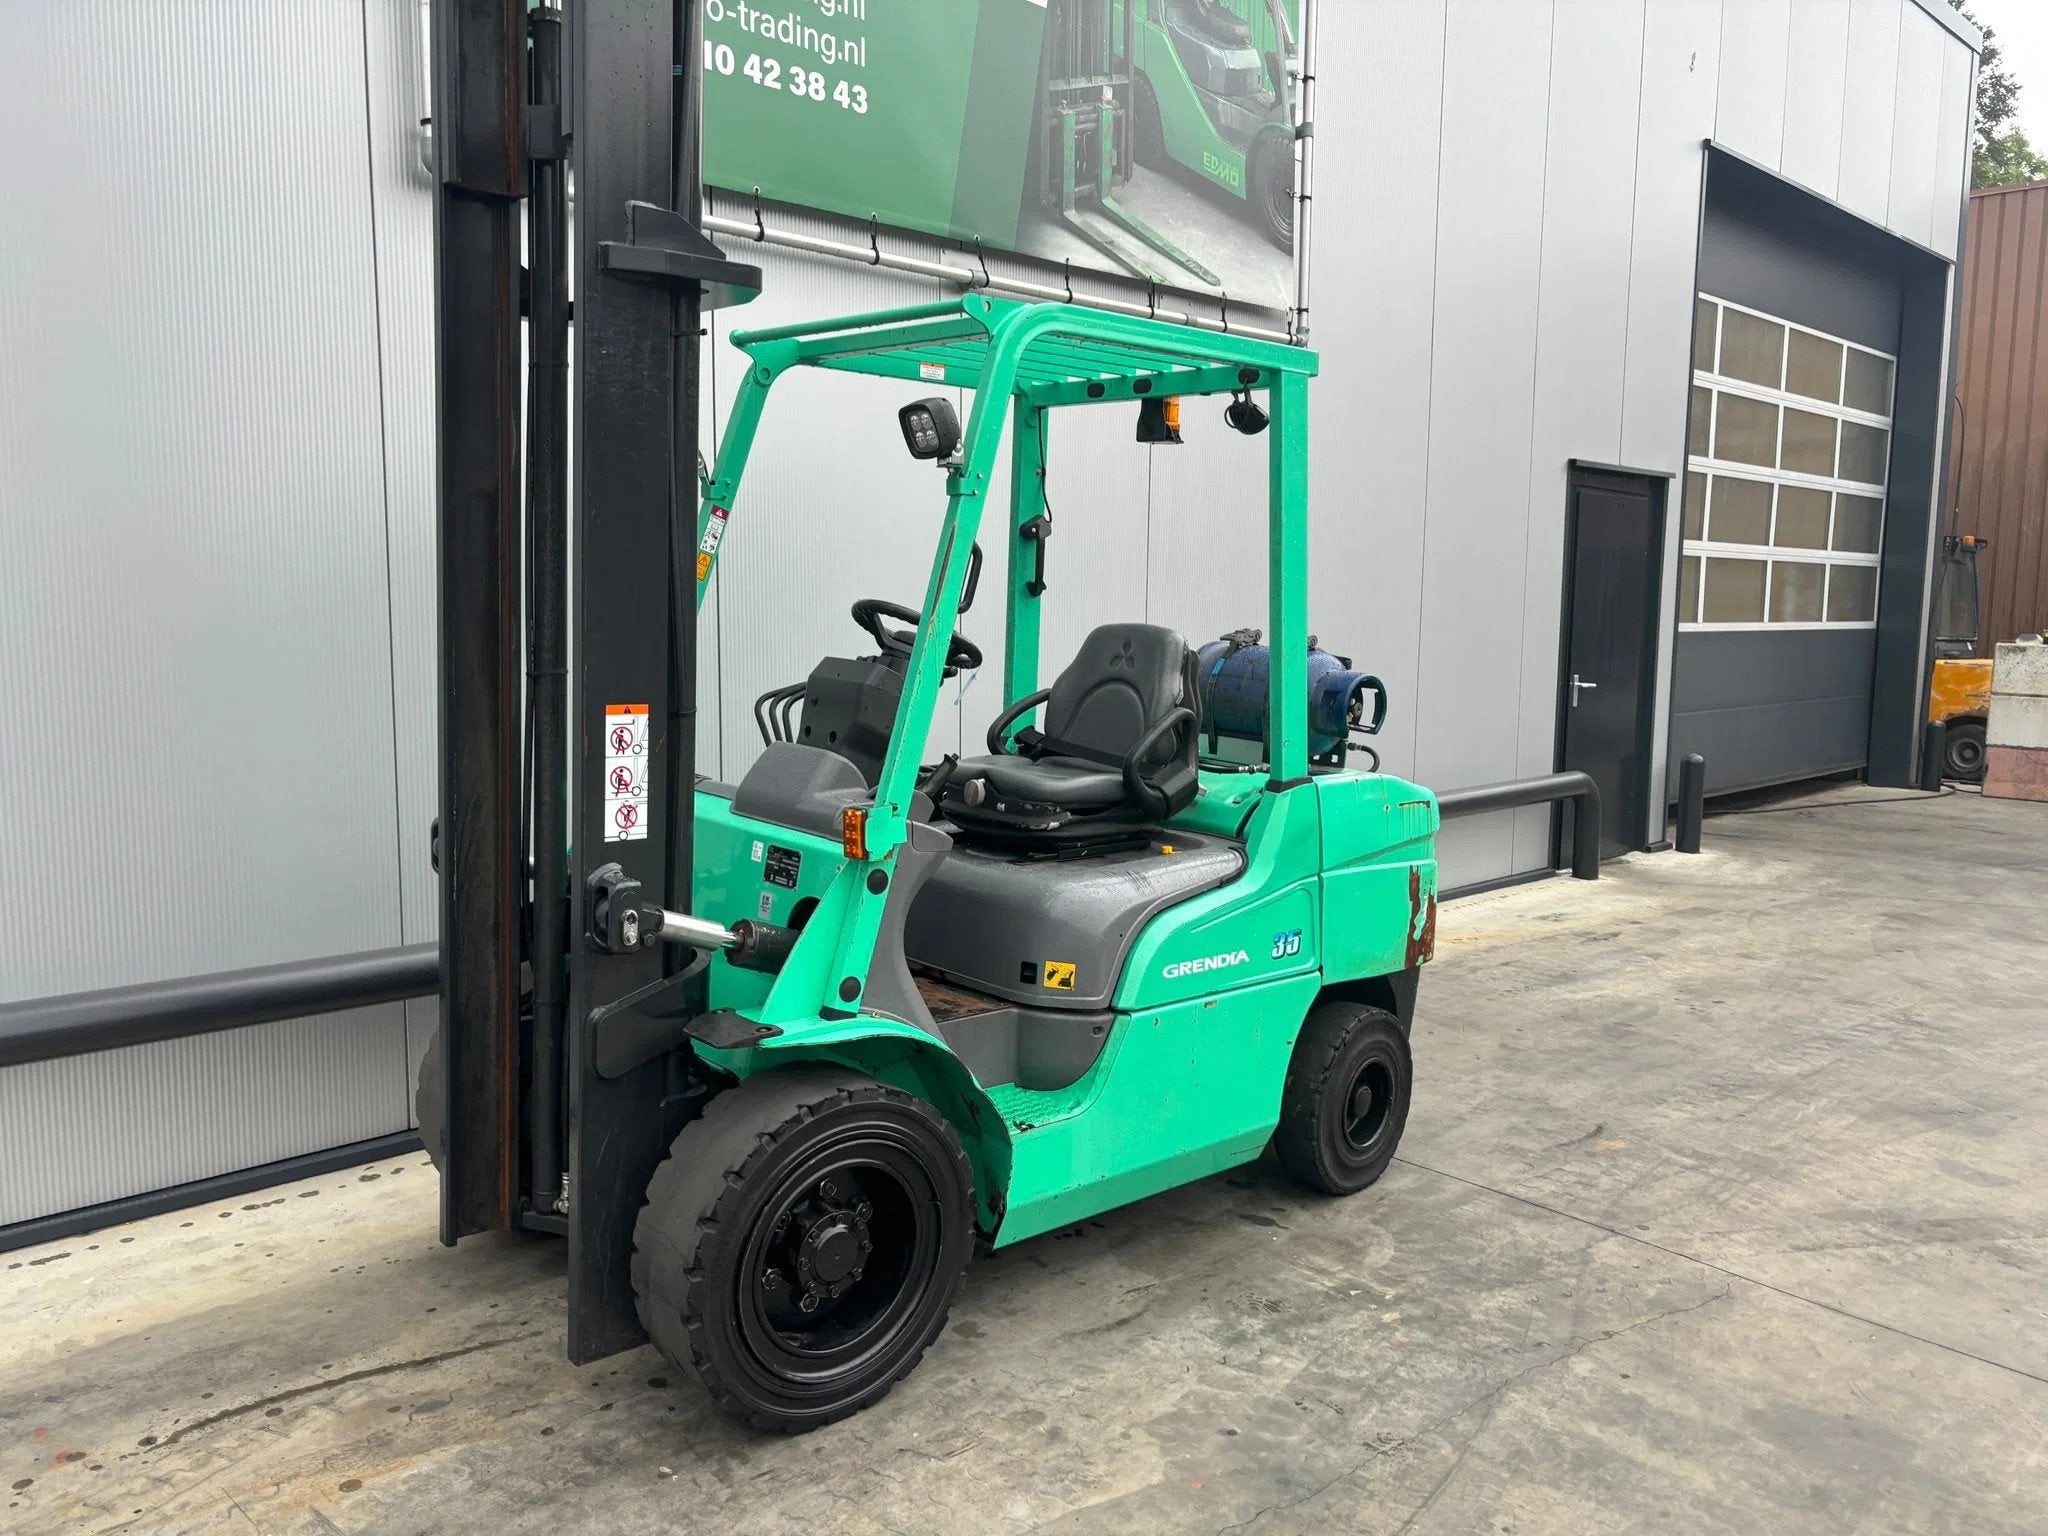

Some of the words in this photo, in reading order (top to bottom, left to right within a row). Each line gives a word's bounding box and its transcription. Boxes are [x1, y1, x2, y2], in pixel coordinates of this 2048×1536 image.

[743, 53, 782, 90] 42
[789, 65, 826, 102] 38
[833, 80, 868, 114] 43
[1203, 151, 1239, 188] EDMO
[1162, 949, 1250, 979] GRENDIA
[1271, 929, 1302, 960] 35
